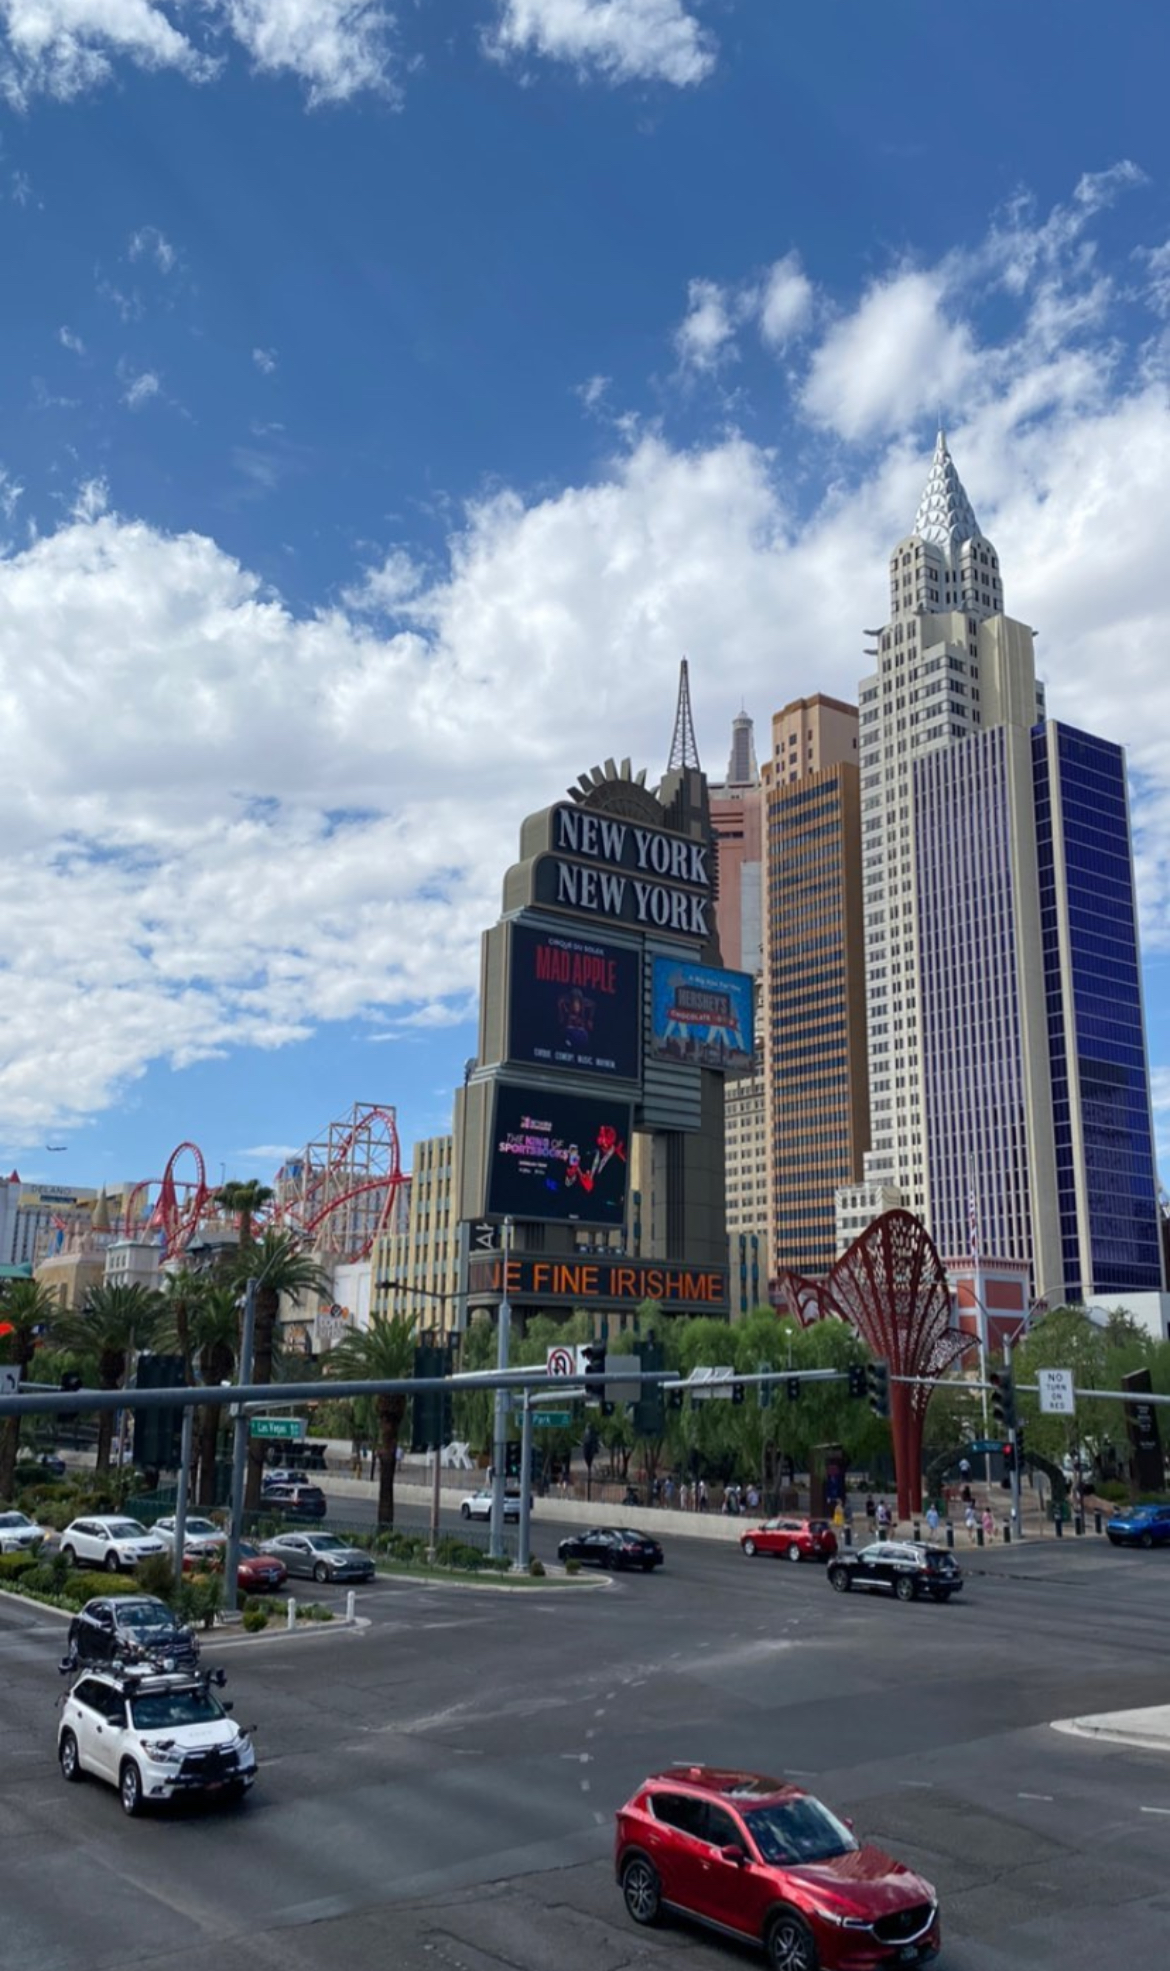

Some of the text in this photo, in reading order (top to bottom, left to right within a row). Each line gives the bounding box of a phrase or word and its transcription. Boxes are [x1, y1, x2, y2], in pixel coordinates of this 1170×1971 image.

[558, 808, 709, 885] NEW YORK
[557, 862, 709, 935] NEW YORK
[536, 944, 617, 995] MAD APPLE
[507, 1133, 525, 1144] THE
[551, 1138, 564, 1148] OF
[533, 1263, 599, 1294] FINE
[610, 1267, 723, 1301] IRISHME
[1048, 1373, 1063, 1382] NO
